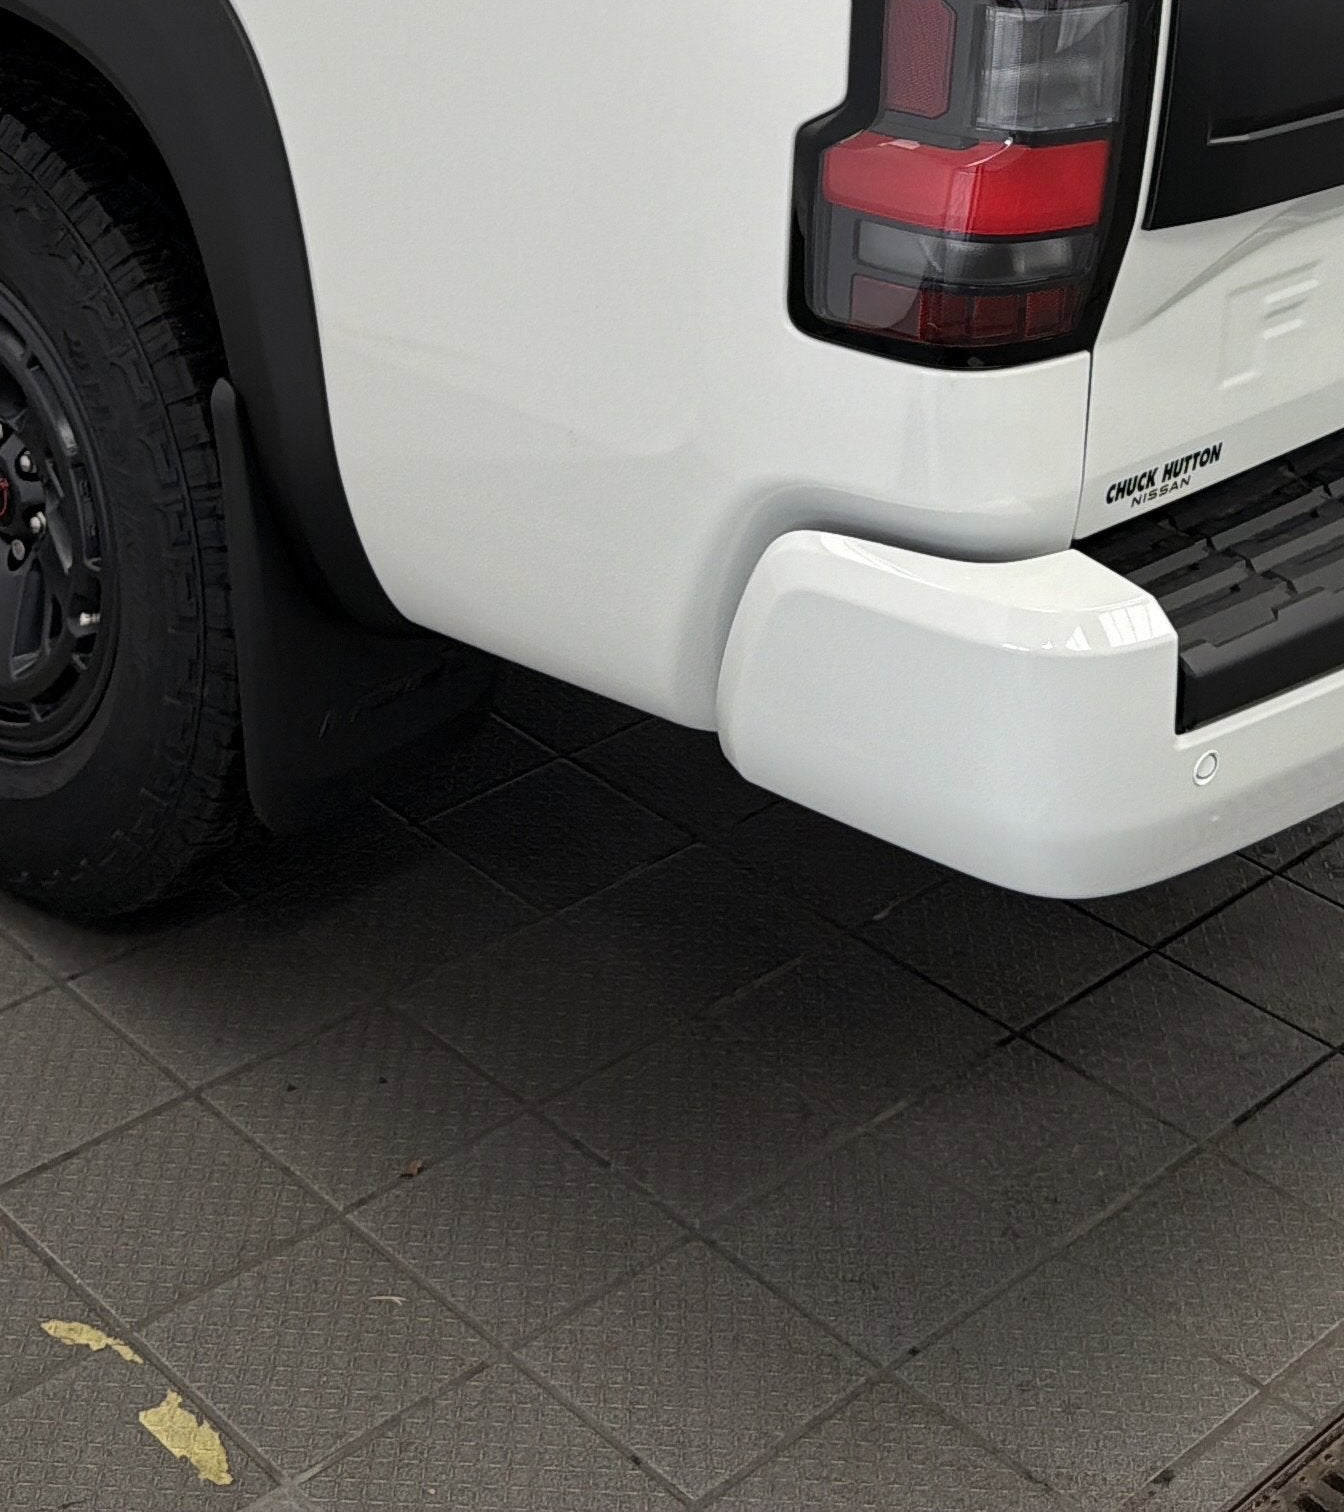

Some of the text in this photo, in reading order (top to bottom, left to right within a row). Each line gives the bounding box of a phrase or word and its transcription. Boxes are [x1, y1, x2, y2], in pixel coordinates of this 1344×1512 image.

[1106, 442, 1223, 504] CHUCK HUTTON
[1130, 475, 1191, 508] NISSAN
